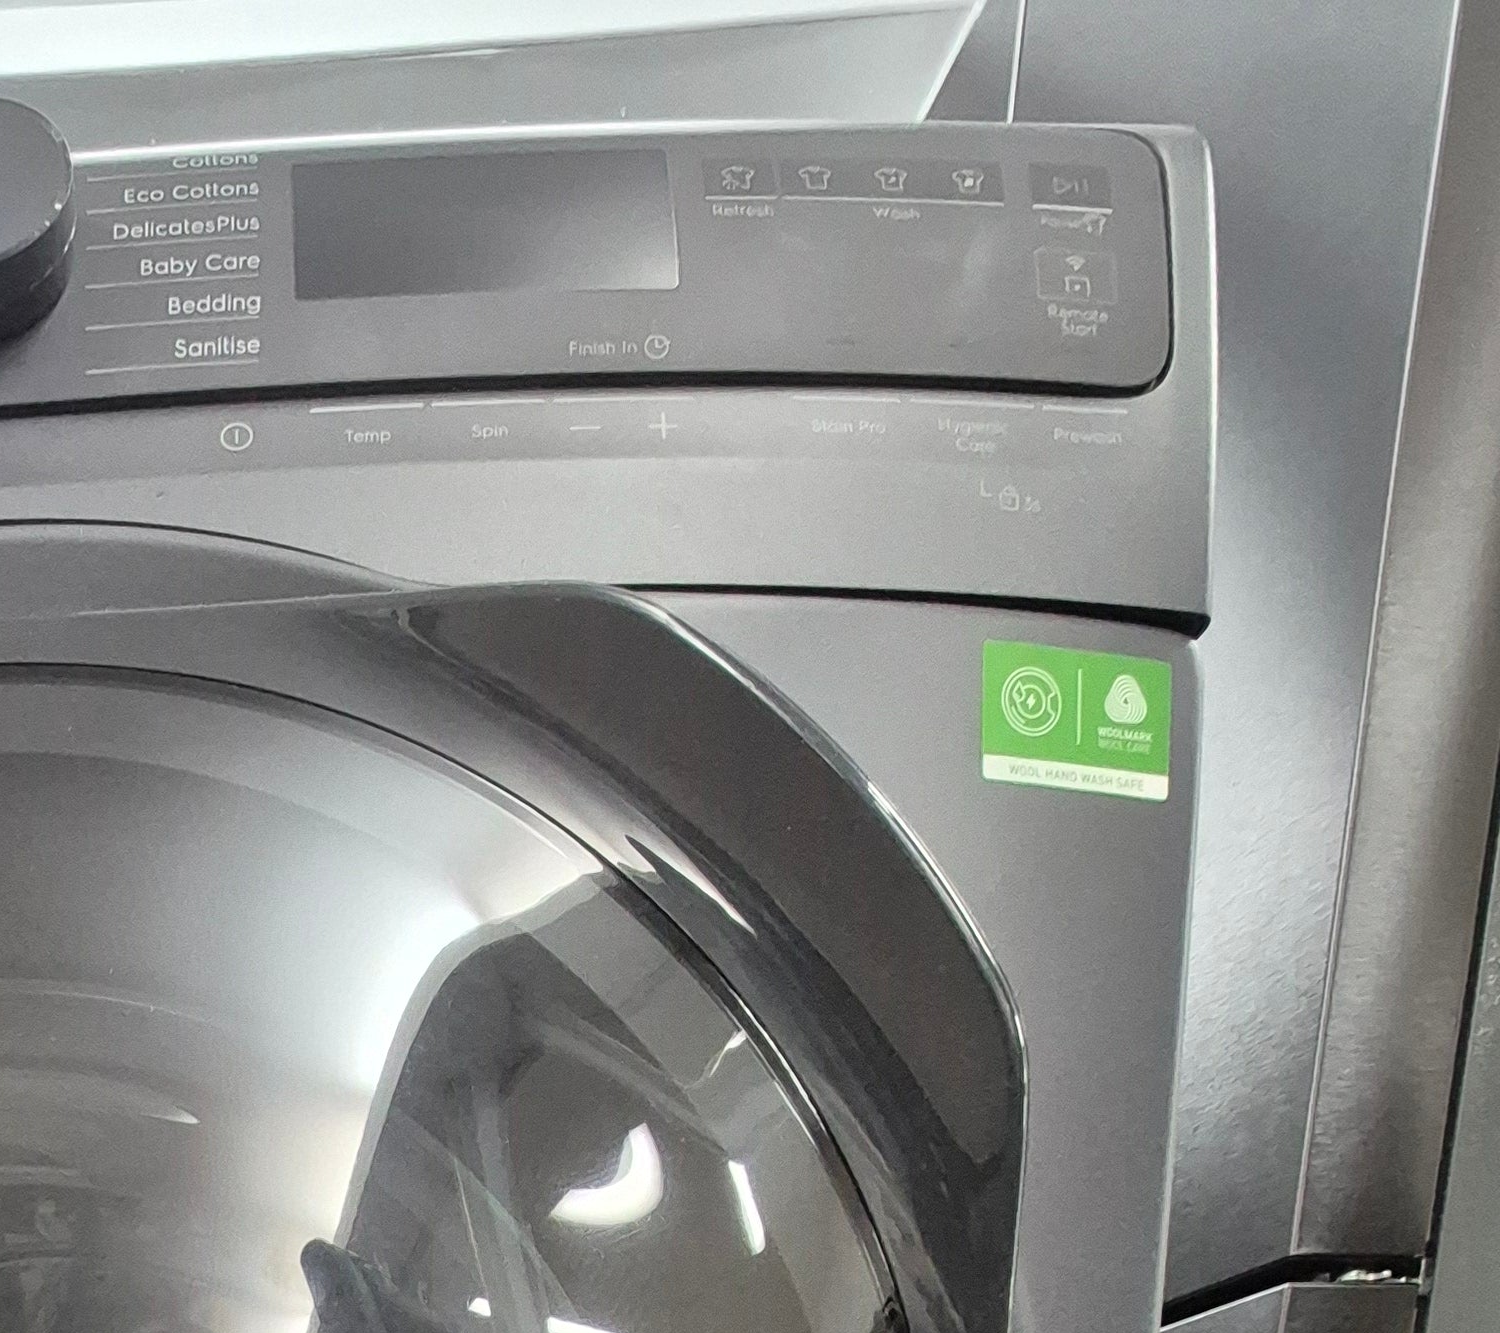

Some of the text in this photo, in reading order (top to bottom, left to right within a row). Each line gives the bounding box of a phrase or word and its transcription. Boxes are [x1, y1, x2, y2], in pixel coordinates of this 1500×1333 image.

[124, 182, 259, 204] Eco Cottons
[113, 215, 260, 240] DelicatesPlus
[140, 253, 260, 276] Baby Care
[168, 293, 261, 315] Bedding
[174, 336, 260, 359] Sanitise
[568, 339, 615, 357] Finish
[345, 428, 392, 445] Temp
[471, 423, 509, 440] Spin
[1097, 726, 1153, 741] WOOLMARK
[1009, 763, 1144, 791] WOOL HAND WASH SAFE
